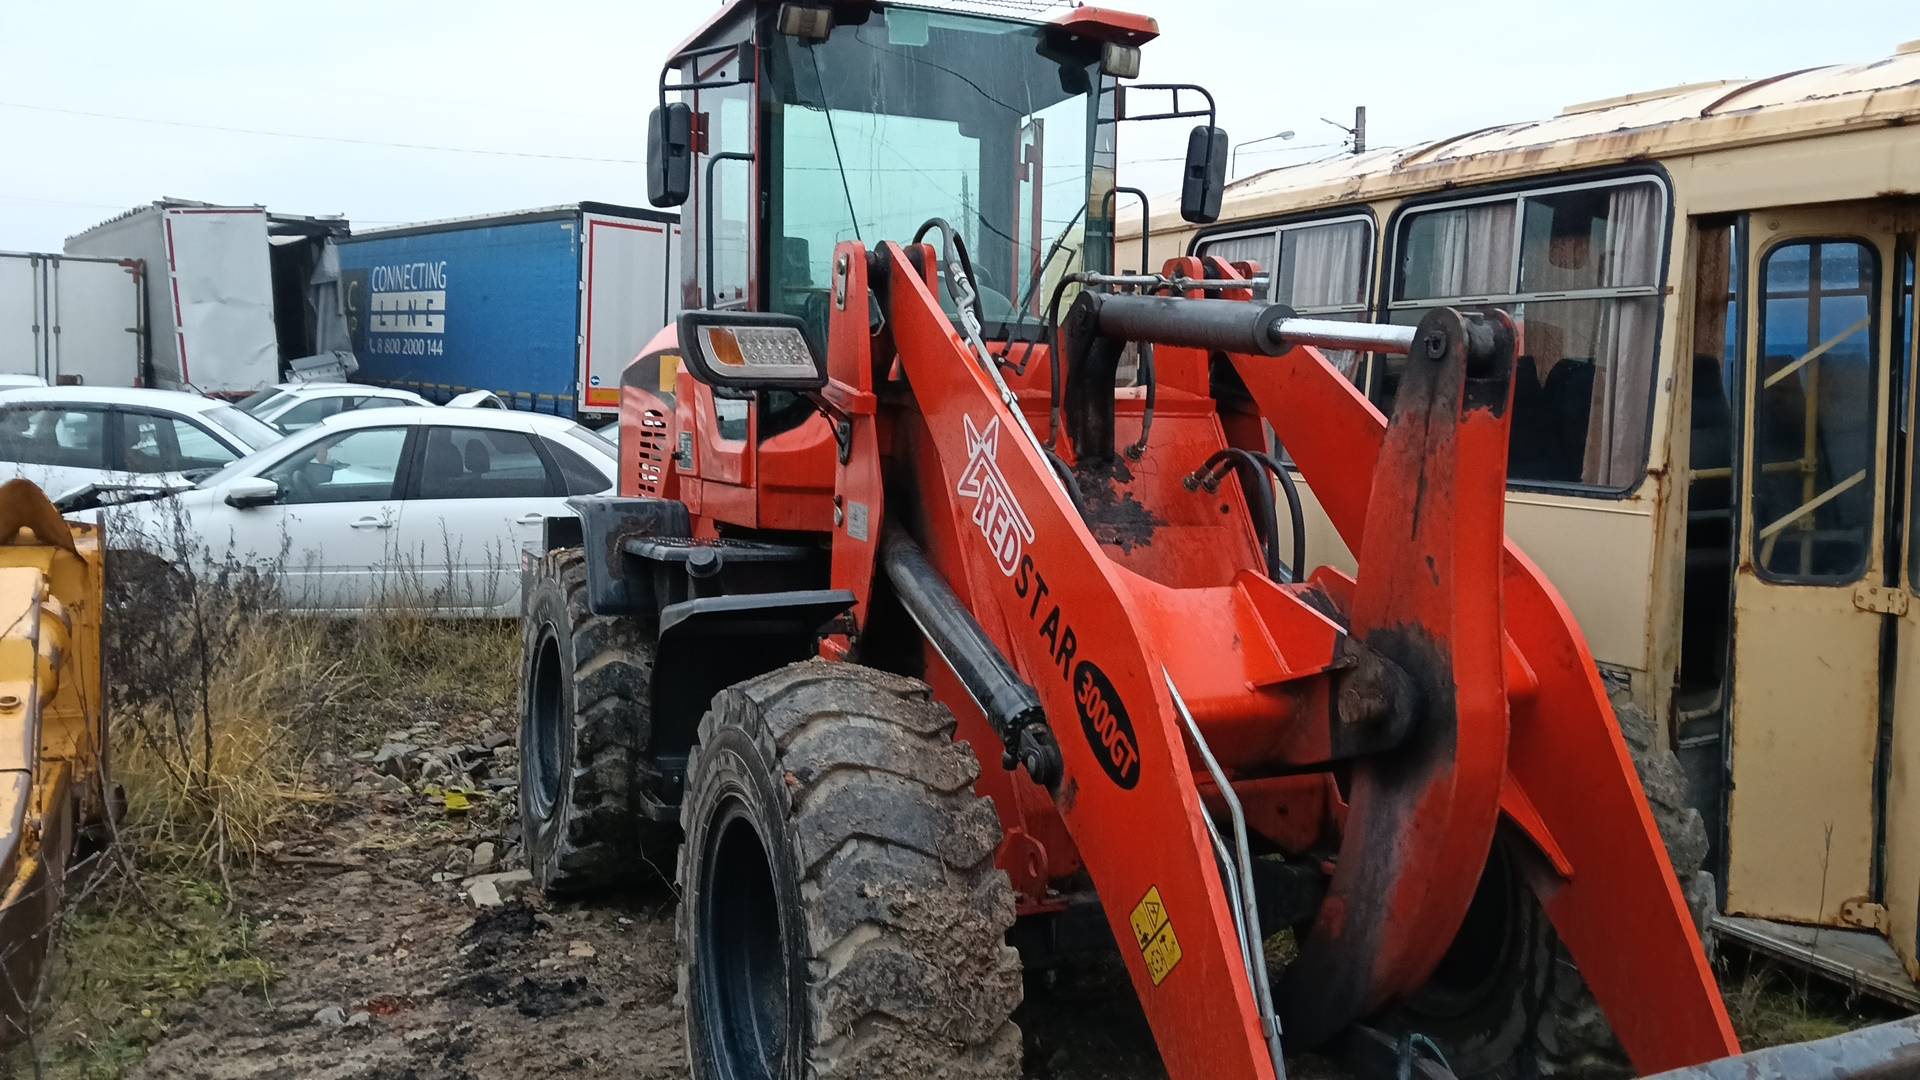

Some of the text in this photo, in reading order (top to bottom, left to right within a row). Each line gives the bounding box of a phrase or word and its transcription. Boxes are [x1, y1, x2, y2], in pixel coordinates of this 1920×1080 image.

[372, 262, 446, 291] CONNECTING
[379, 298, 434, 327] LINE
[377, 338, 443, 356] 8 800 2000 144
[1015, 554, 1077, 681] STAR
[1077, 671, 1137, 778] 3000GT
